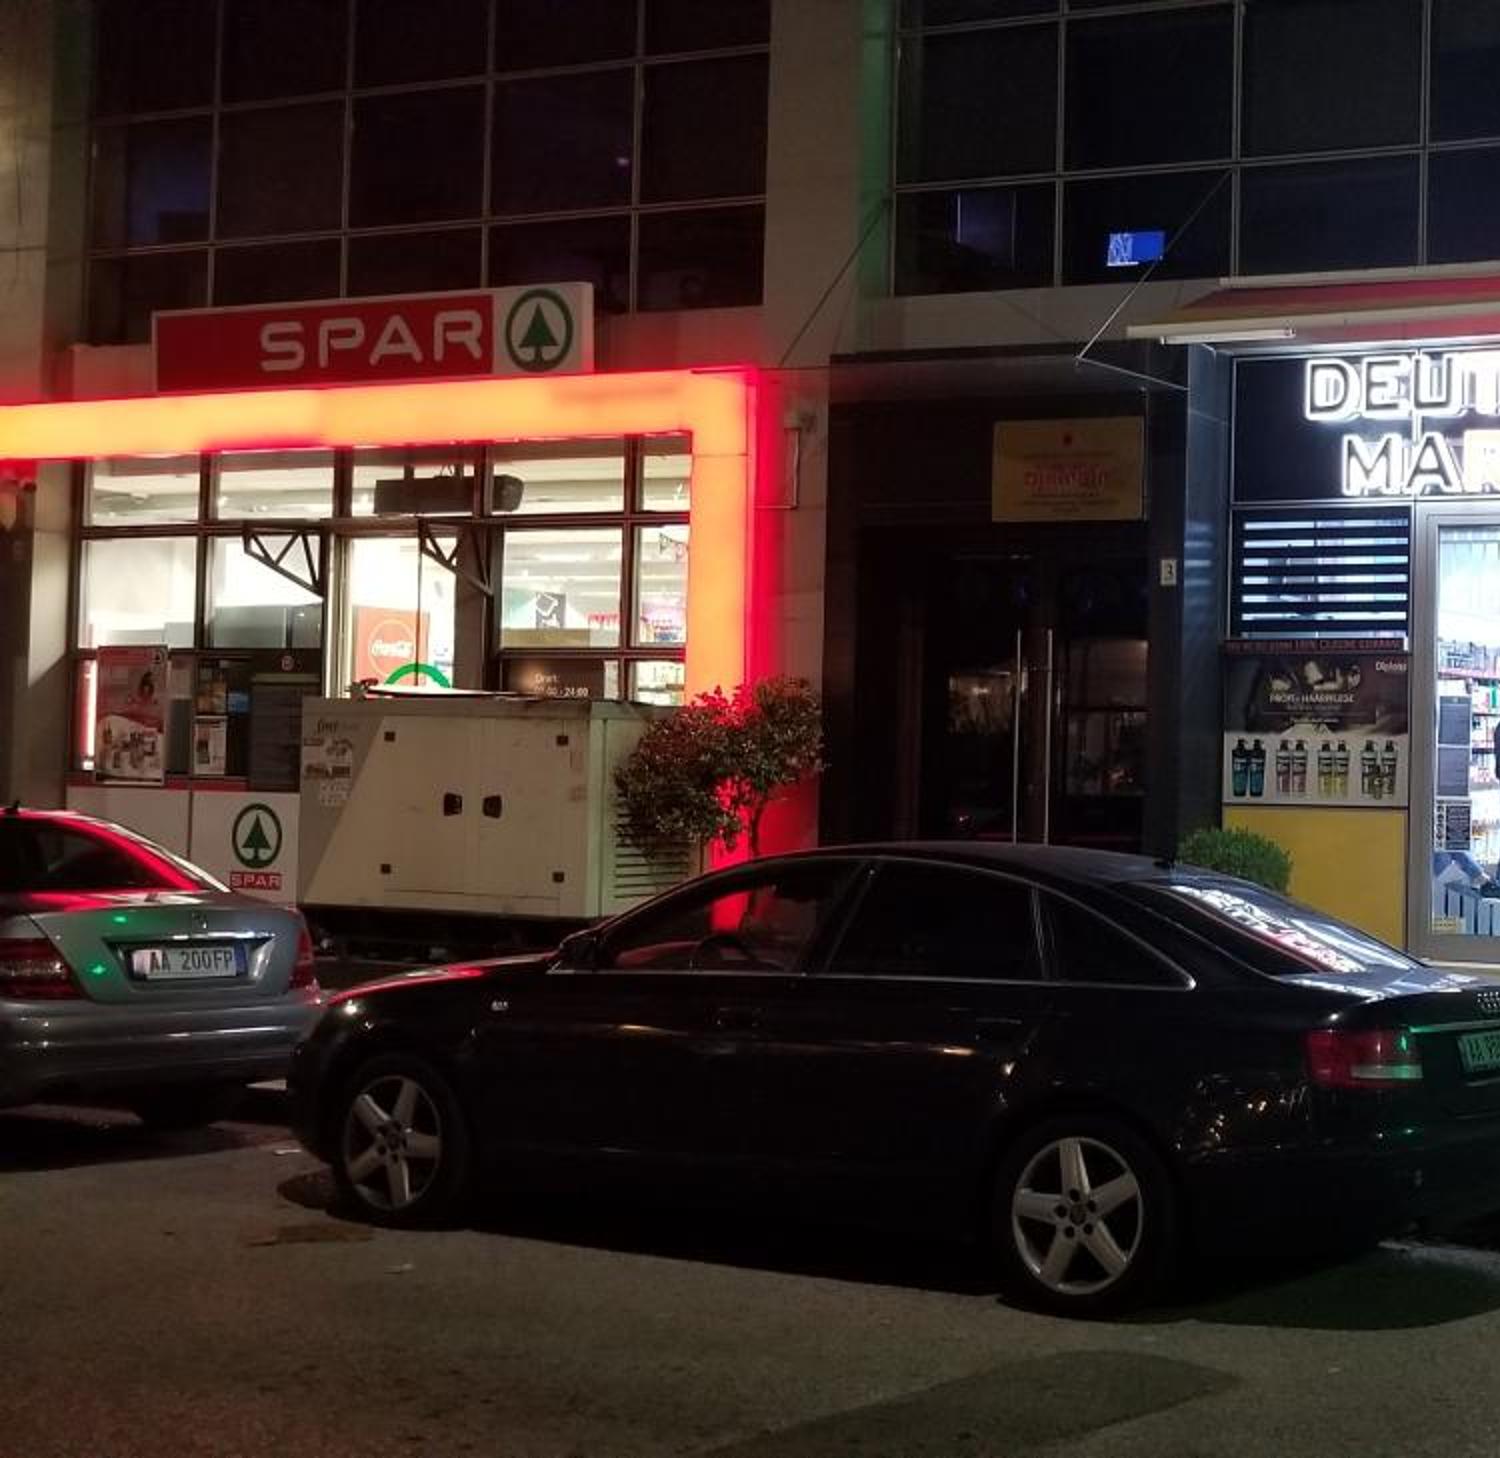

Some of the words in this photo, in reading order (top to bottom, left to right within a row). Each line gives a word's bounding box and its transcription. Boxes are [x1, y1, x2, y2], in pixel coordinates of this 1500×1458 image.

[260, 309, 482, 371] SPAR
[231, 874, 281, 888] SPAR
[150, 951, 170, 971] AA
